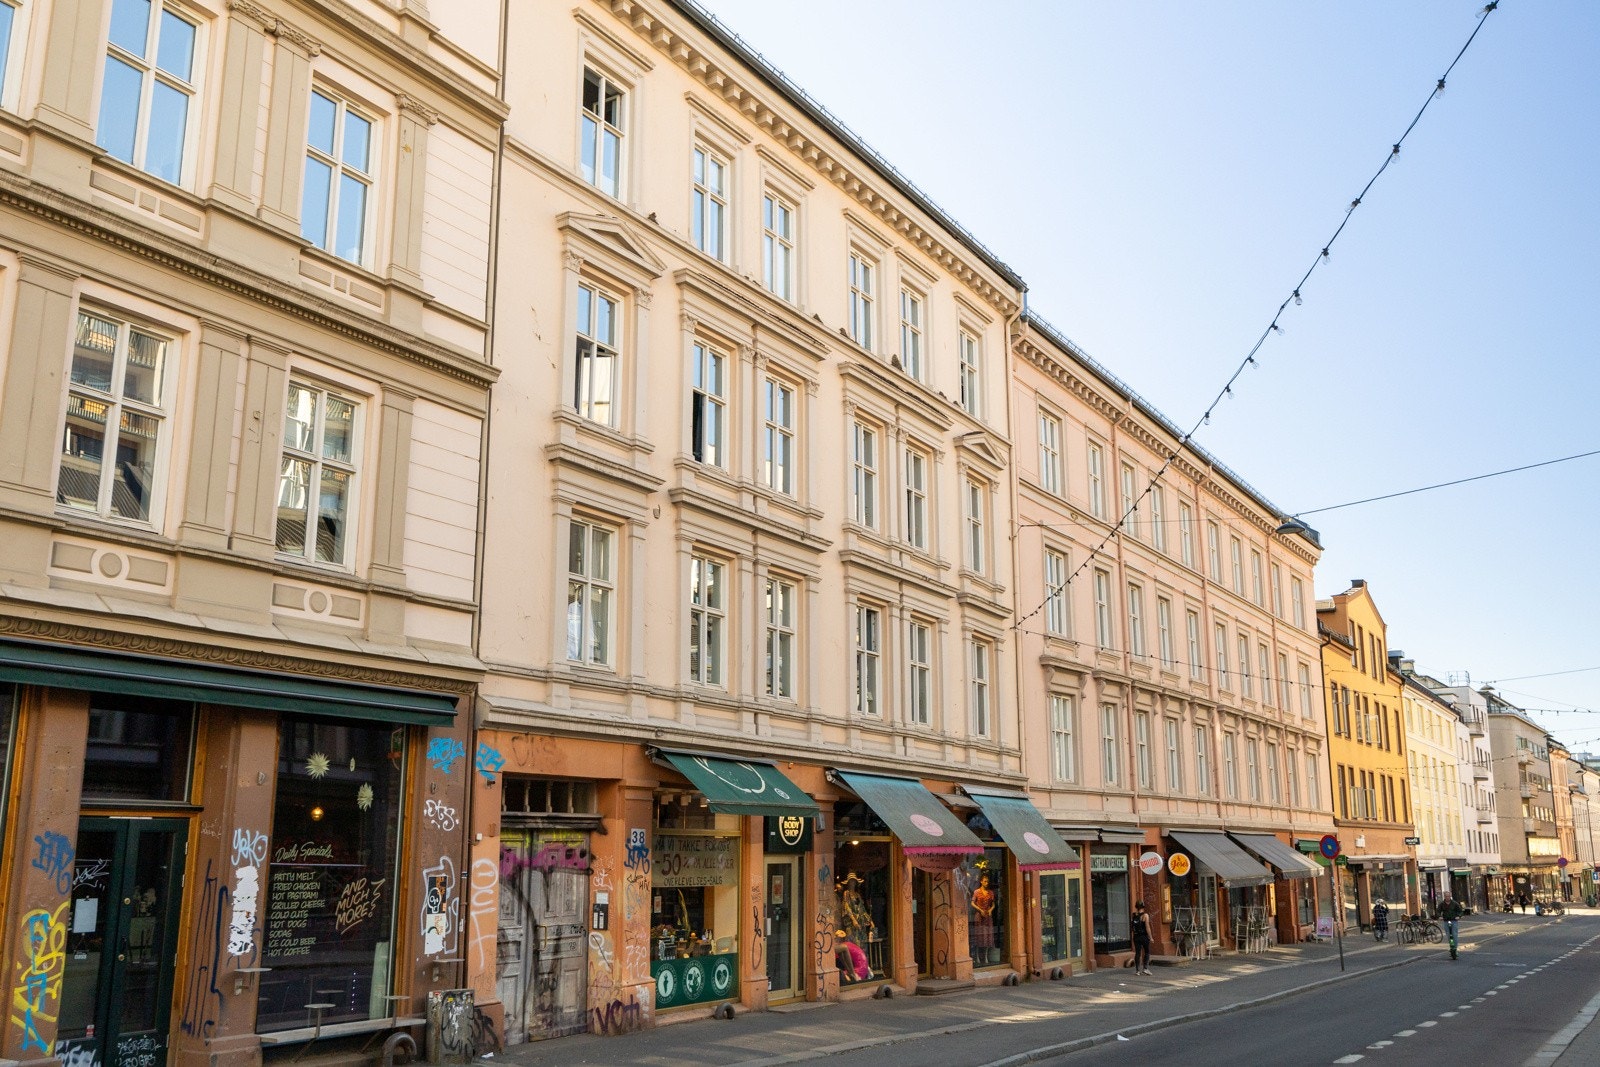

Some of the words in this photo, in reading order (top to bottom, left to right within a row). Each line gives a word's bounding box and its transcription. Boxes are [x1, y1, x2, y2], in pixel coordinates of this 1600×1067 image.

[783, 821, 800, 829] BODY
[631, 830, 646, 844] 38
[784, 829, 799, 837] SHOP
[678, 839, 701, 852] TAKKE
[275, 844, 299, 863] Daily
[300, 841, 334, 861] Specials
[274, 872, 295, 881] PATTY
[296, 871, 316, 880] MELT
[273, 882, 292, 891] FRIED
[293, 881, 320, 890] CHICKEN
[341, 877, 367, 899] AND
[272, 892, 286, 900] HOT
[287, 891, 319, 900] PASTRAMI
[272, 901, 300, 910] GRILLED
[300, 900, 326, 908] CHEESE
[335, 888, 370, 916] MUCH
[270, 911, 289, 919] COLD
[290, 910, 309, 919] CUTS
[270, 920, 285, 928] HOT
[287, 920, 308, 928] DOGS
[269, 929, 292, 938] SODAS
[268, 939, 280, 947] ICE
[280, 938, 299, 947] COLD
[300, 936, 317, 946] BEER
[267, 948, 282, 957] HOT
[283, 946, 311, 956] COFFEE
